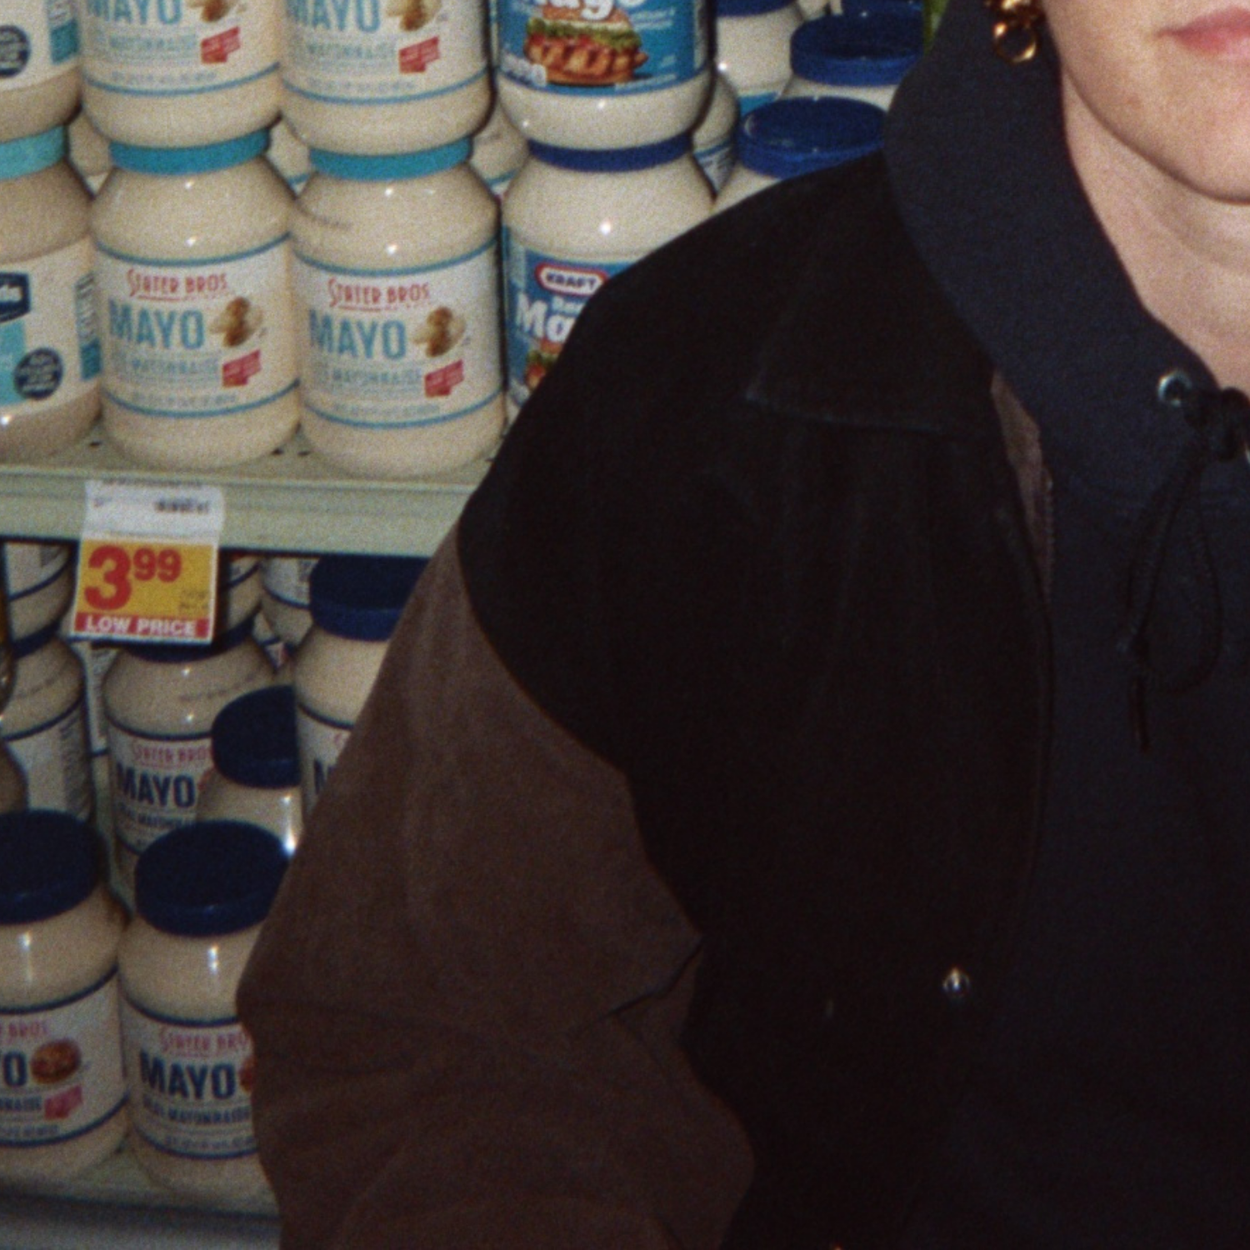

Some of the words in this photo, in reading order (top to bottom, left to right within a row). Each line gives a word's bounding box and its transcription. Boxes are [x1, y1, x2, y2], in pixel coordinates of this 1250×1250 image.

[127, 268, 180, 297] STATER
[185, 273, 228, 293] BROS
[328, 278, 381, 307] STATER
[386, 282, 430, 302] BROS
[108, 299, 204, 349] MAYO
[309, 308, 407, 360] MAYO
[516, 293, 575, 342] Ma
[86, 616, 132, 634] LOW
[137, 618, 196, 637] PRICE
[116, 763, 195, 808] MAYO
[140, 1050, 236, 1100] MAYO
